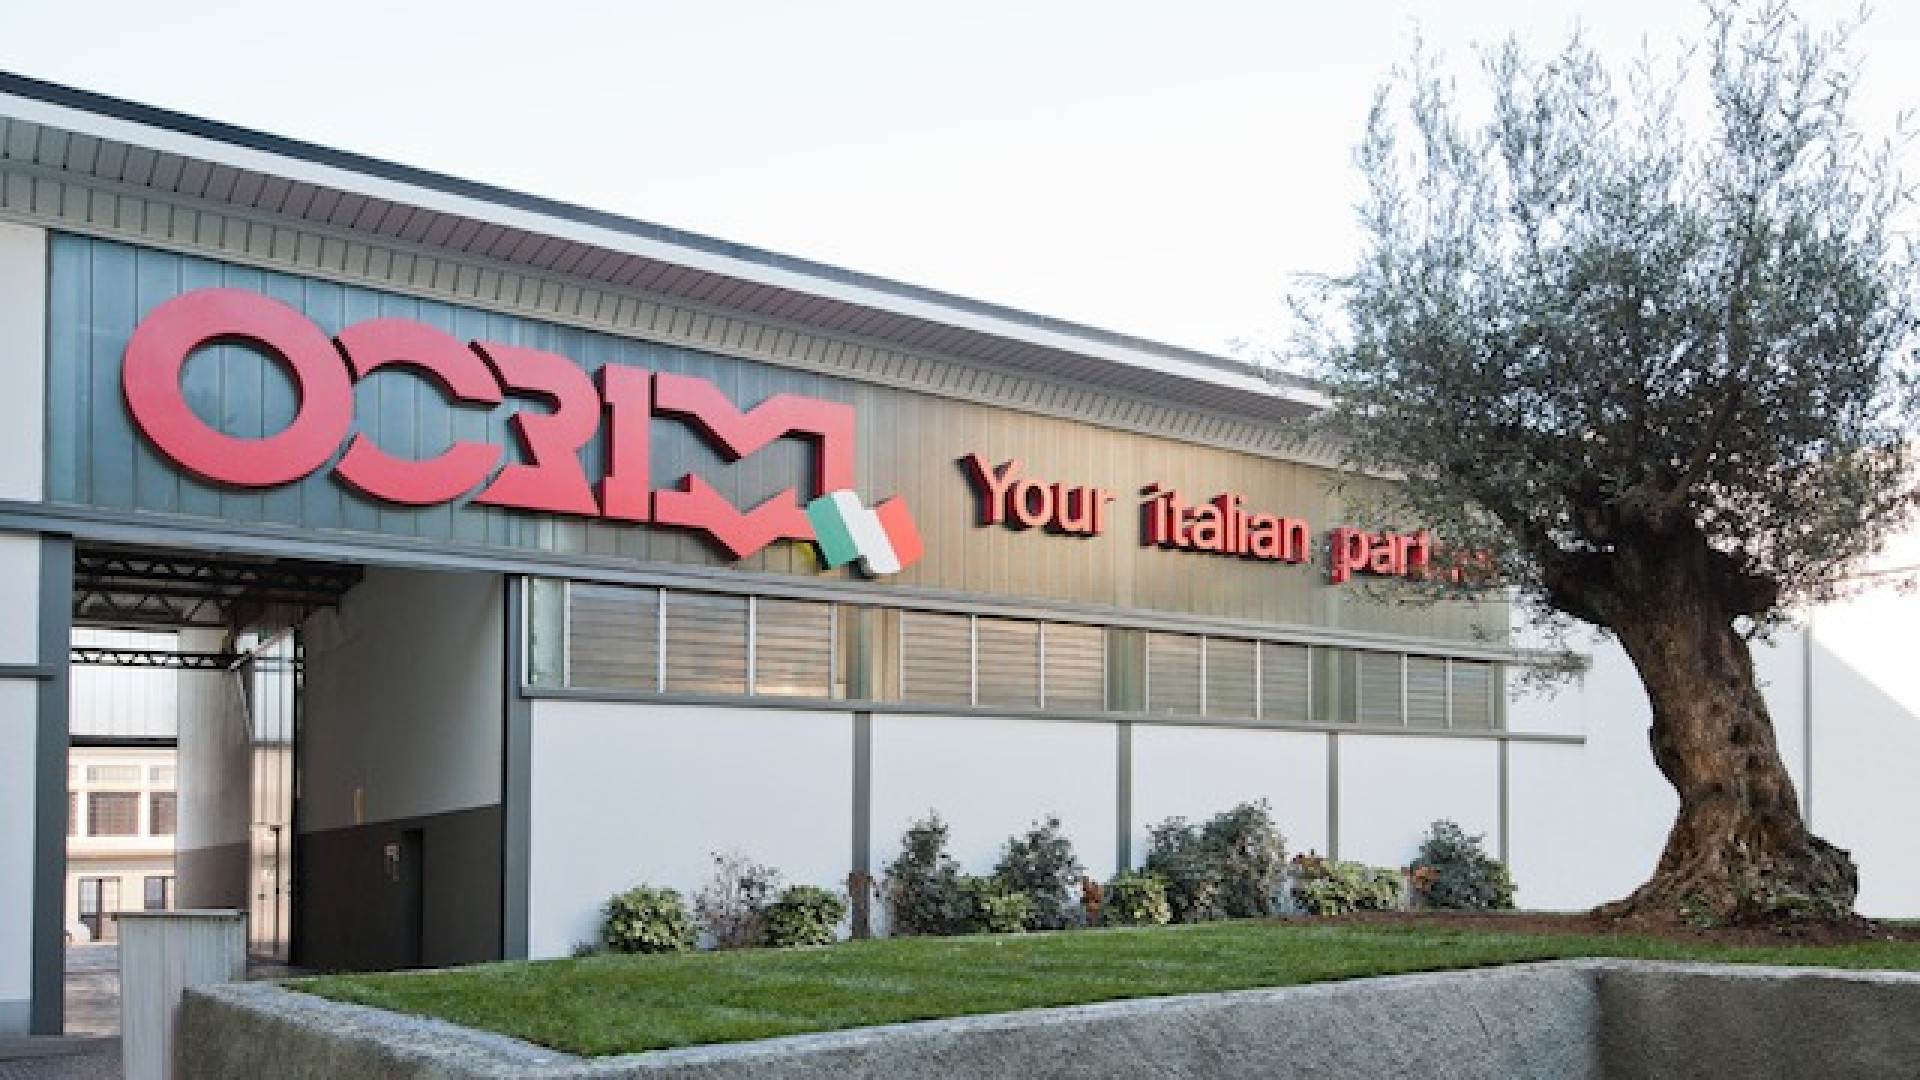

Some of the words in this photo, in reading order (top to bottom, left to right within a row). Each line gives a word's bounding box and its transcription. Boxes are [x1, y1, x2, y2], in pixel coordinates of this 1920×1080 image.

[121, 288, 857, 560] OCRIM
[964, 452, 1114, 537] Your
[1138, 483, 1311, 564] italian
[1327, 525, 1496, 584] part
